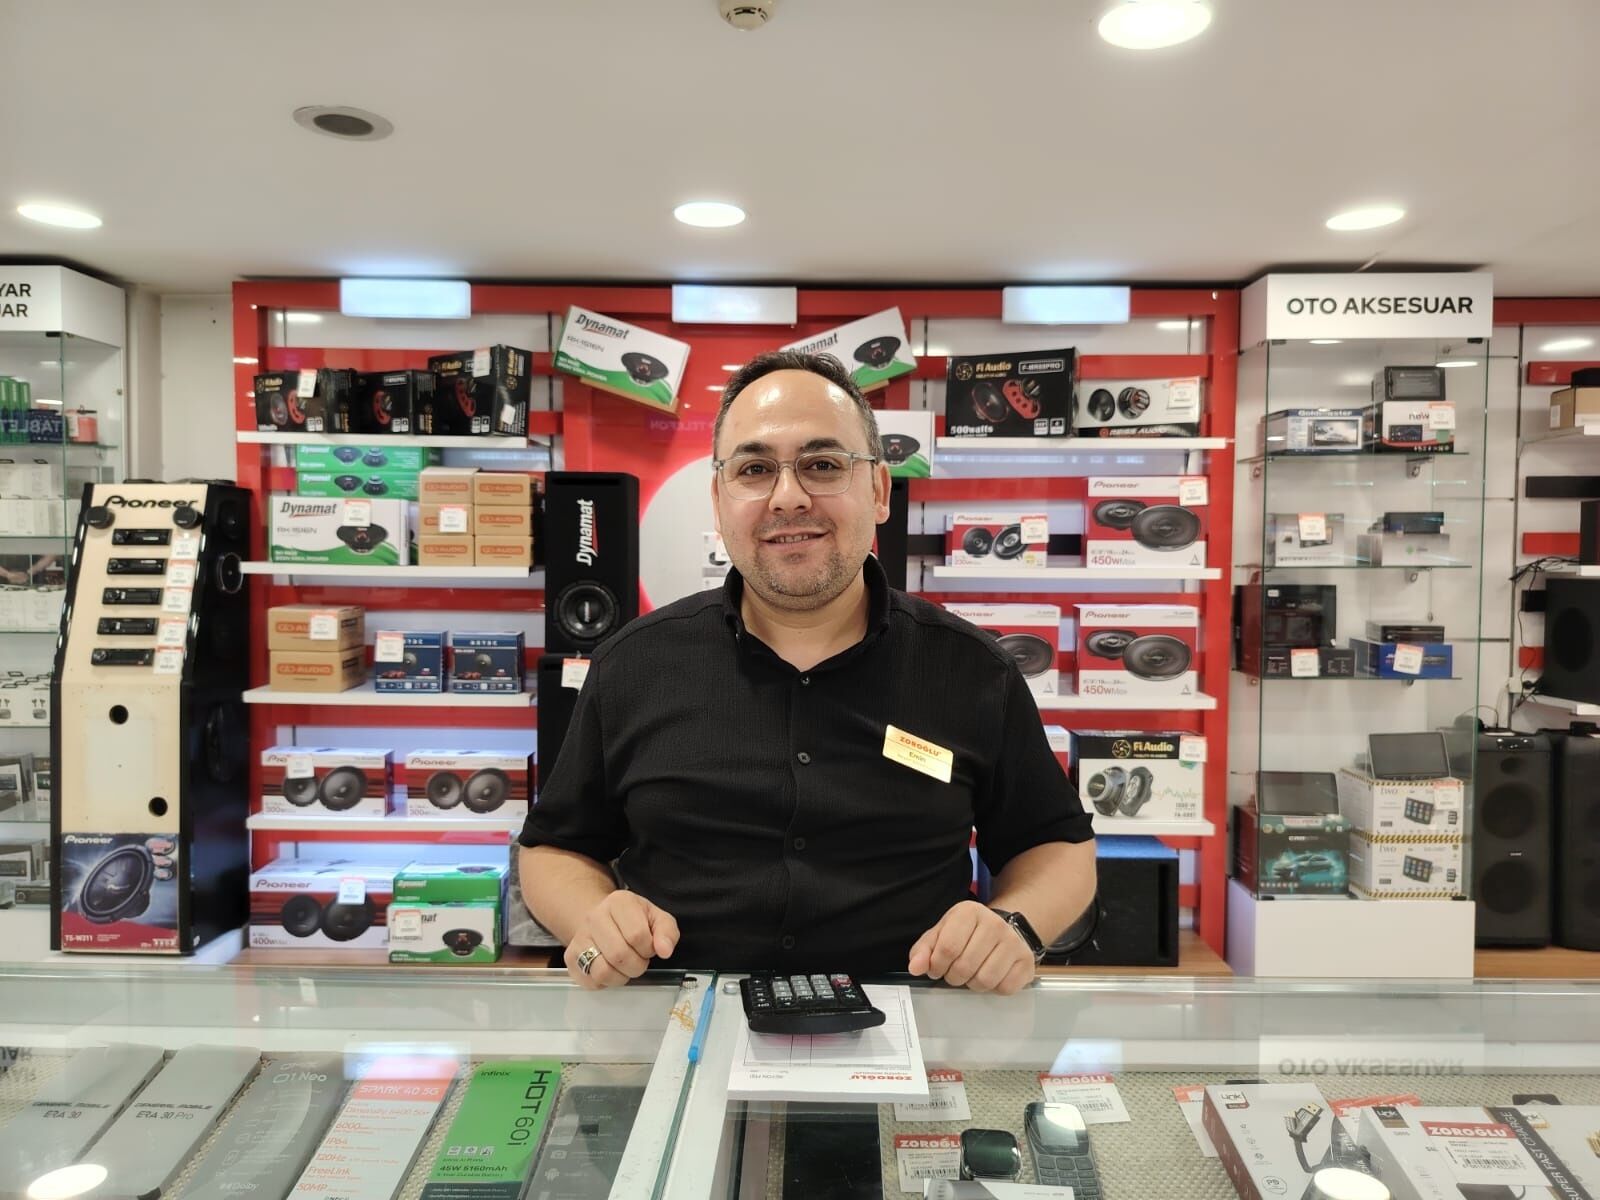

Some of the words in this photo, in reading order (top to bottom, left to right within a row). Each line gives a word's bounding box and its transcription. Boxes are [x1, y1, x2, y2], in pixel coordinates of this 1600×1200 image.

[1287, 298, 1337, 314] OTO
[1343, 297, 1473, 314] AKSESUAR
[576, 314, 629, 340] Dynamat
[985, 362, 1011, 371] Audio
[1094, 481, 1139, 489] Pioneer
[104, 495, 198, 508] Pioneer
[280, 501, 337, 517] Dynamat
[576, 499, 596, 566] Dynamat
[1085, 611, 1131, 619] Pioneer
[1144, 742, 1174, 752] Audio
[411, 757, 456, 766] Pioneer
[64, 835, 113, 844] Pioneer
[255, 879, 312, 889] Pioneer
[299, 1072, 327, 1082] Neo
[359, 1086, 400, 1095] SPARK
[403, 1087, 420, 1095] 40
[421, 1087, 439, 1096] 5G
[520, 1070, 552, 1114] HOT
[67, 1111, 82, 1119] 30
[136, 1111, 158, 1119] ERA
[161, 1111, 175, 1119] 30
[175, 1111, 194, 1120] Pro
[507, 1117, 535, 1146] 60i
[1428, 1123, 1508, 1137] ZOROĞLU
[1502, 1111, 1536, 1146] CHARGE
[1530, 1147, 1559, 1171] FAST
